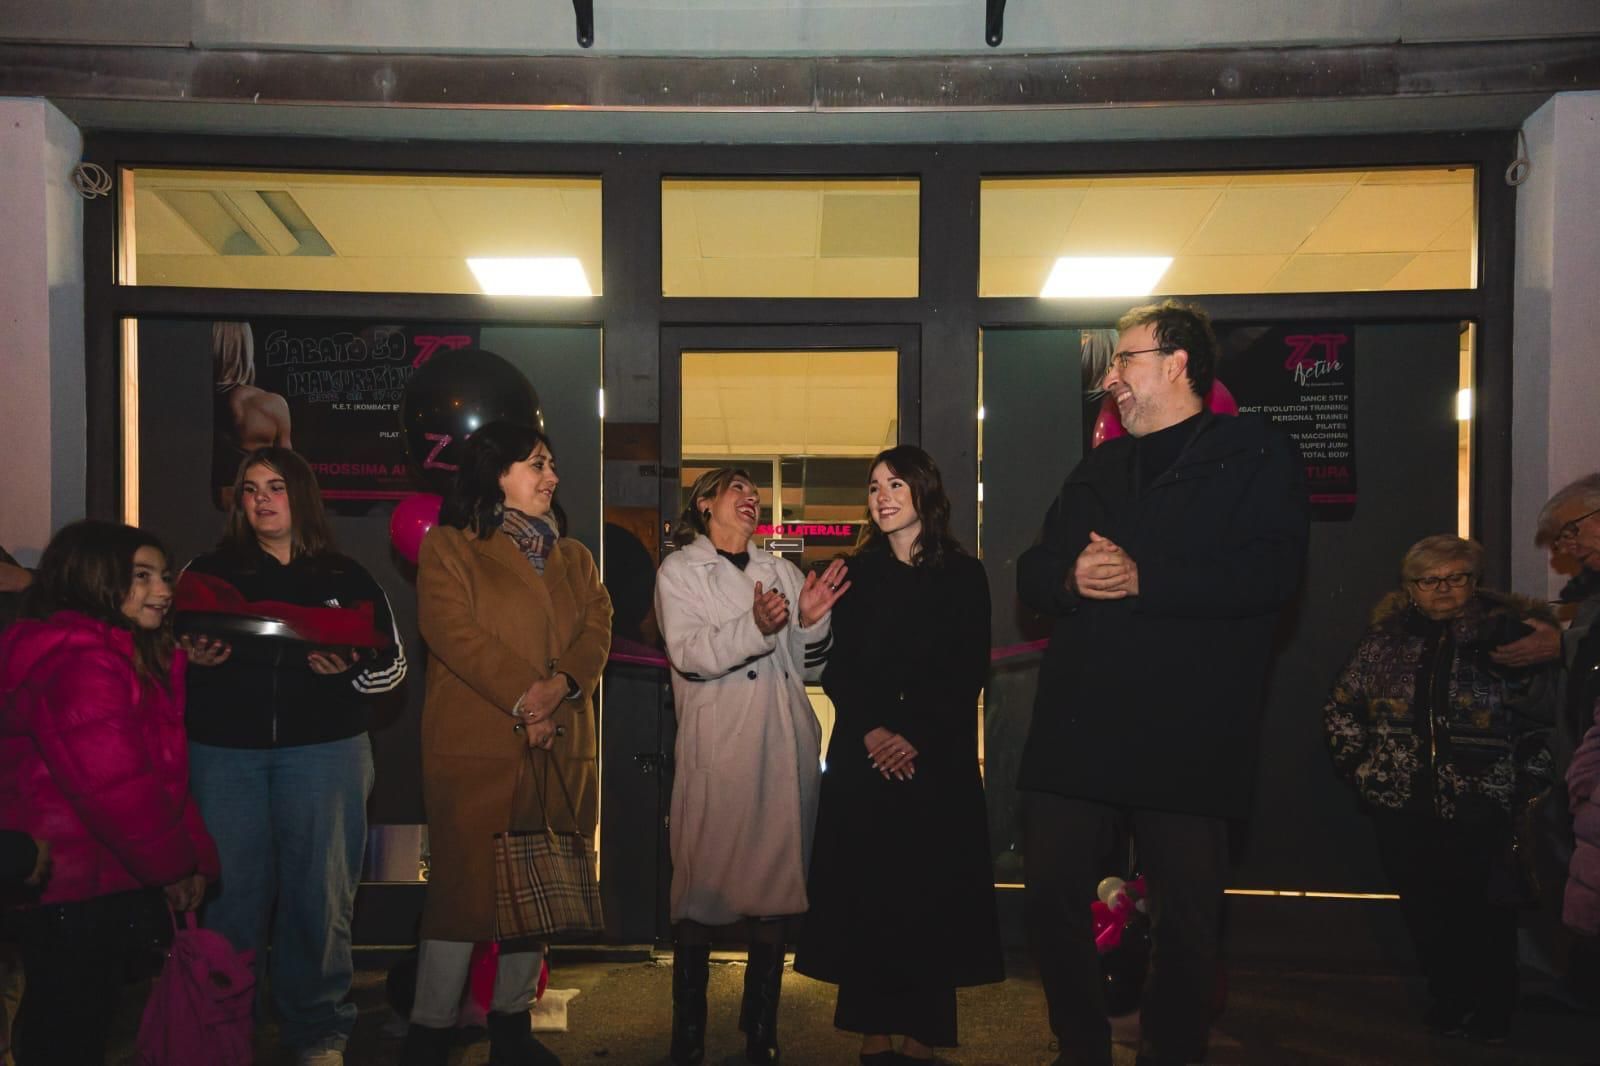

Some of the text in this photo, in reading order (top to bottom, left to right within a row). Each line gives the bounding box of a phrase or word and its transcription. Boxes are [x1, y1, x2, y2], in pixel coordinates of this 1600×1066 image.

[1285, 334, 1347, 369] ZT
[1294, 359, 1343, 386] Active
[1263, 405, 1308, 413] EVOLUTION
[424, 432, 471, 471] Z
[311, 463, 387, 476] PROSSIMA
[787, 525, 852, 536] LATERALE
